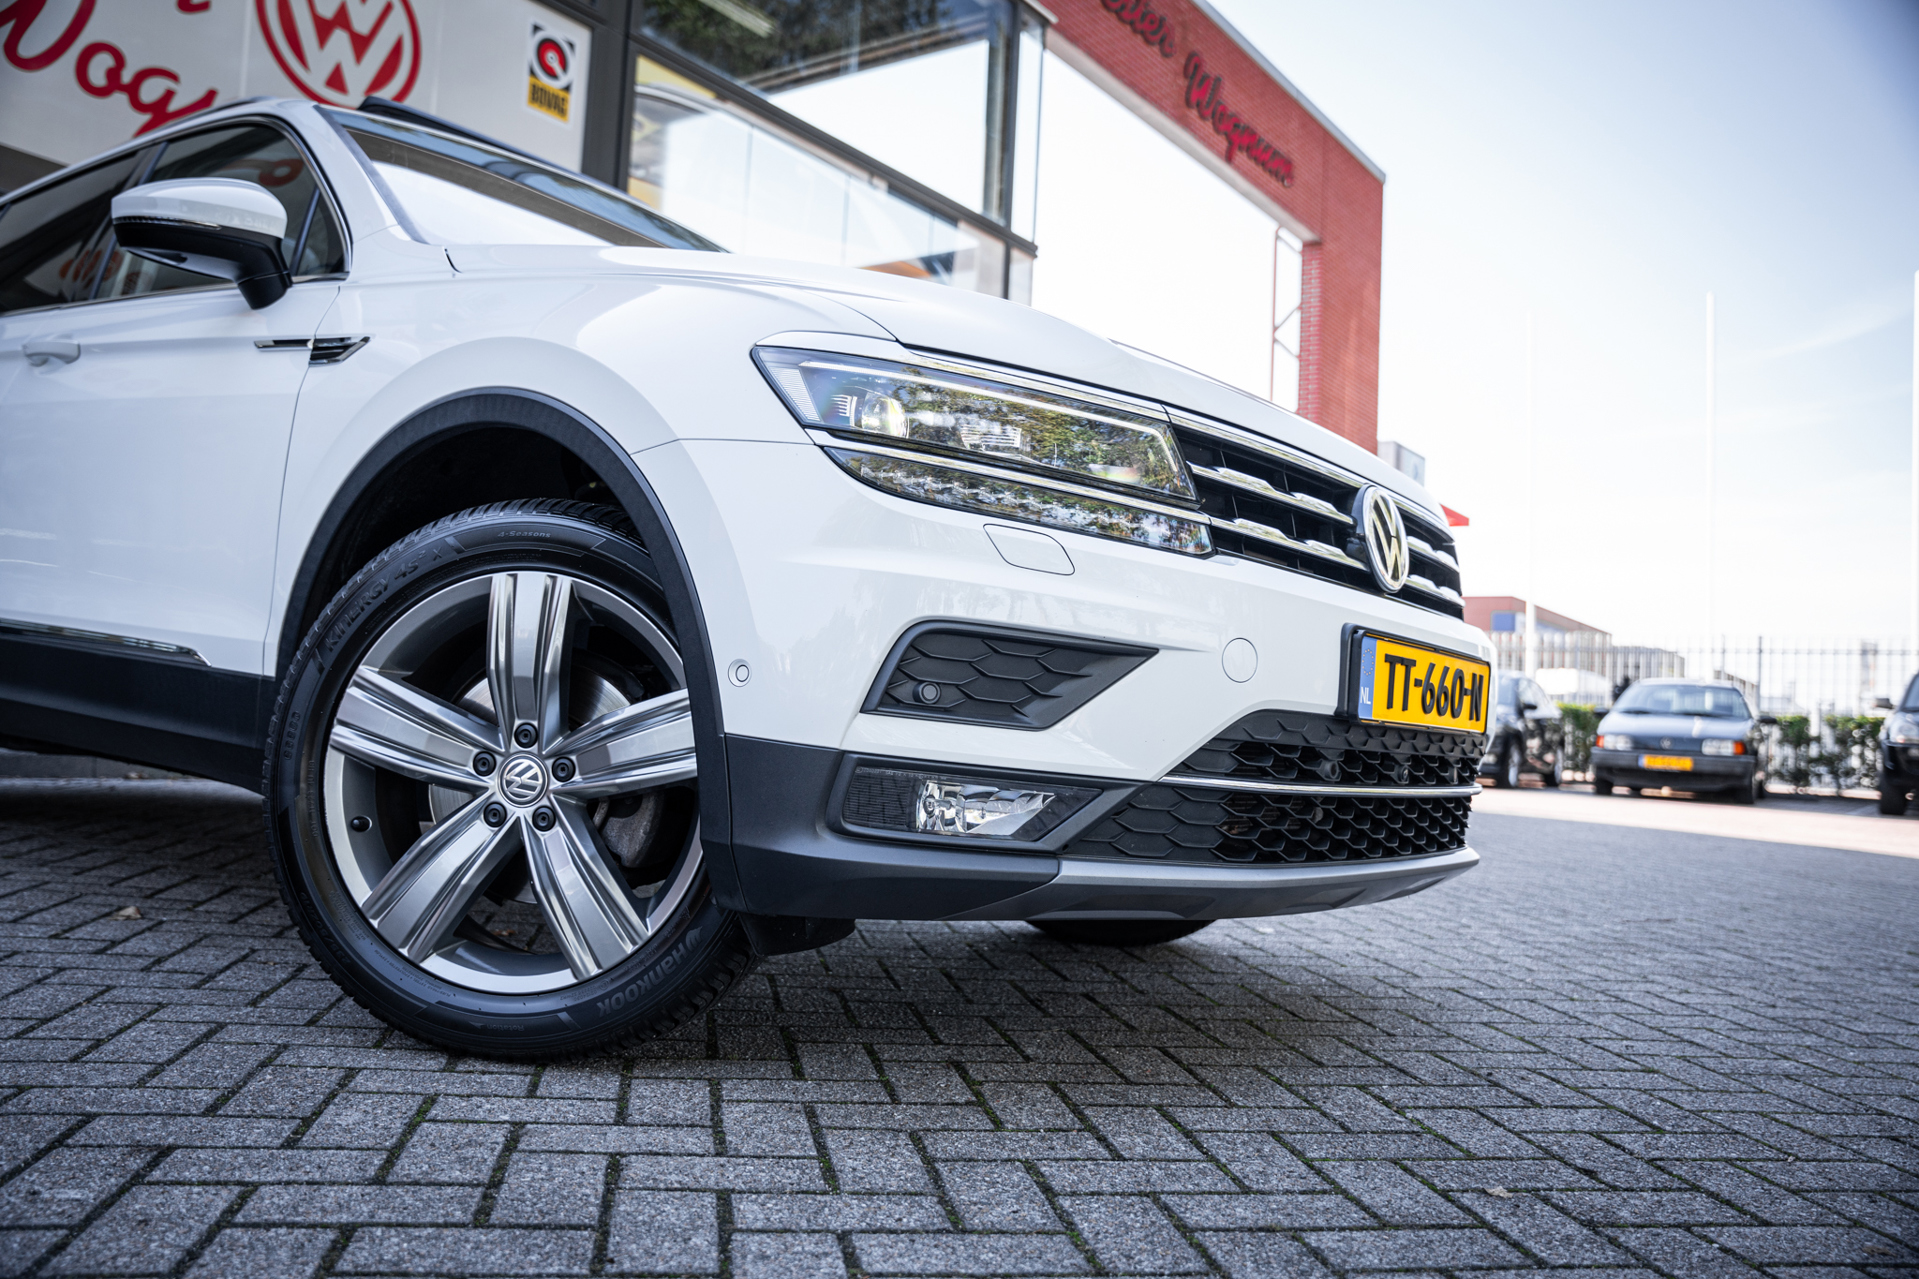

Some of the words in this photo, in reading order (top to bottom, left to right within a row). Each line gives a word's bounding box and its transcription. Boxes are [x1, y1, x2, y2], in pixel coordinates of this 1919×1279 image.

[497, 529, 552, 538] 4-Seasons
[1364, 486, 1409, 592] VW
[1359, 686, 1371, 706] NL
[1384, 653, 1484, 722] TT-660-N
[486, 1023, 526, 1032] Rotation
